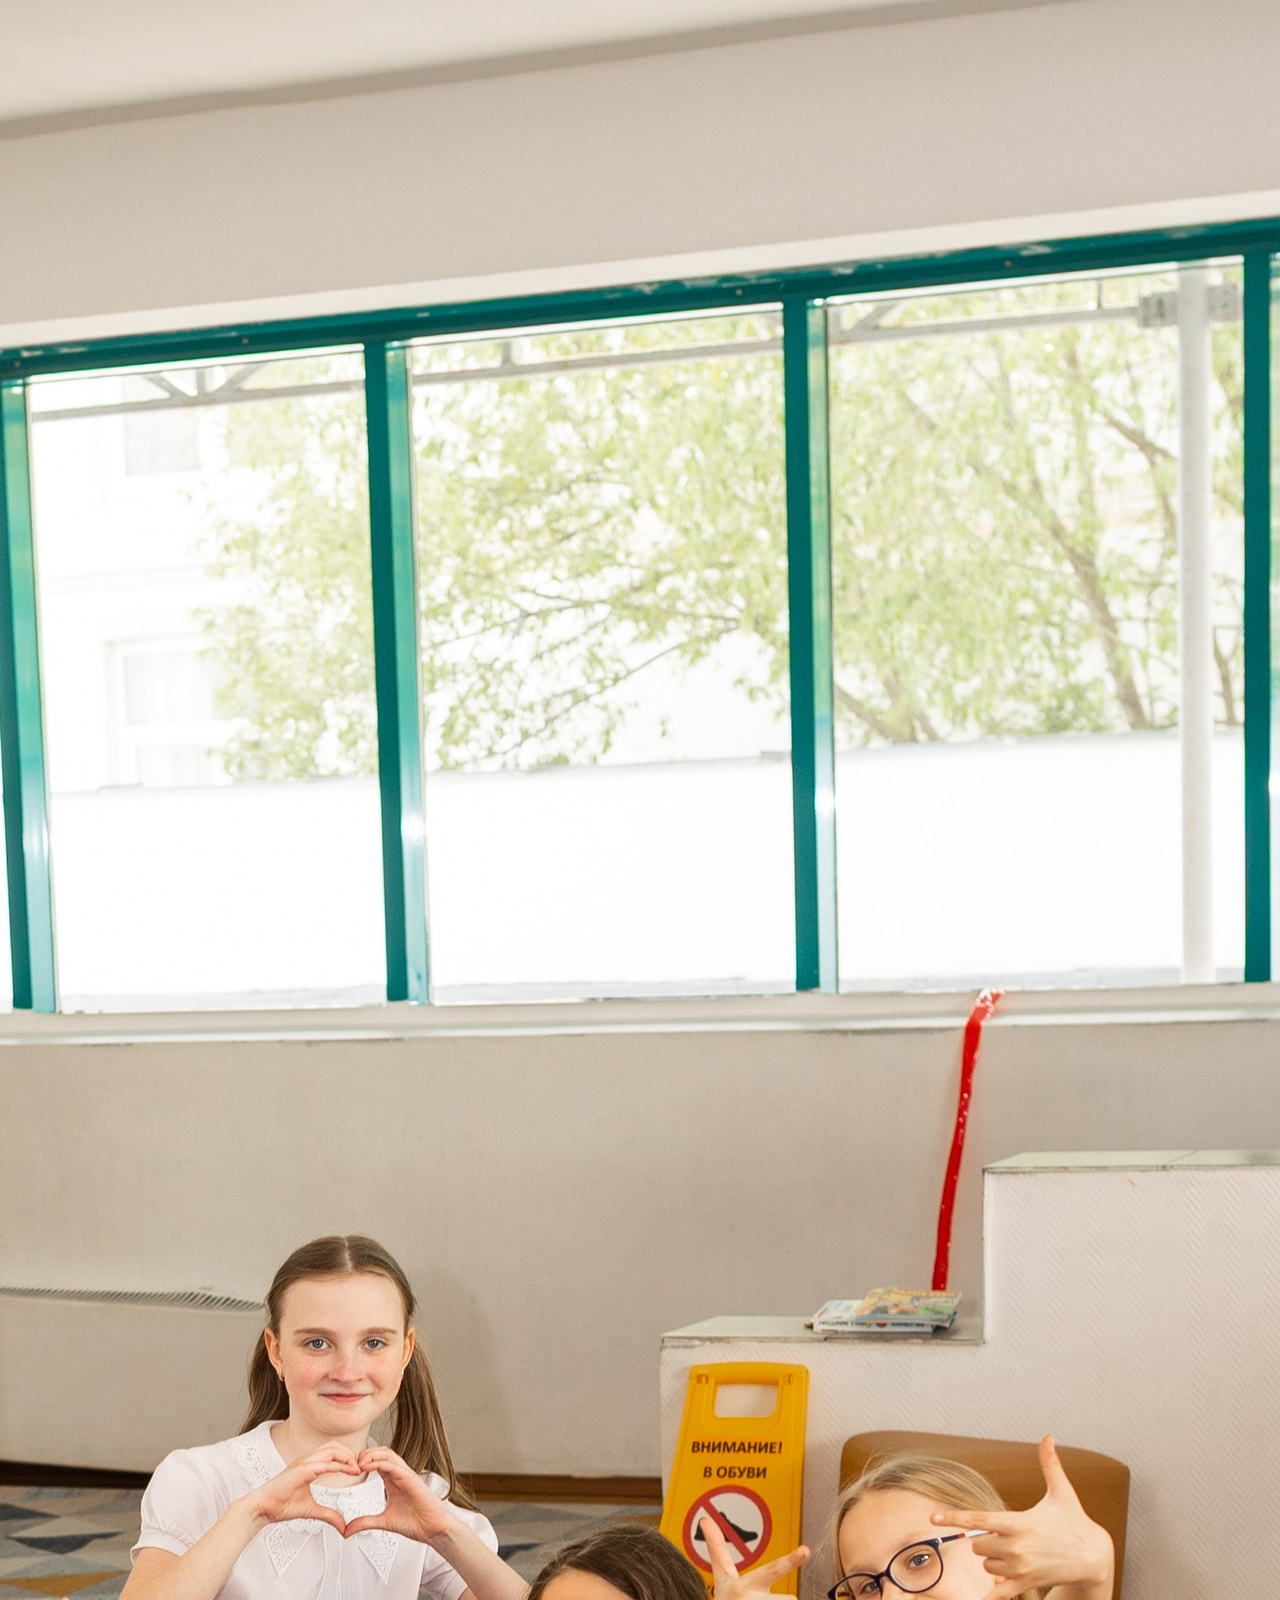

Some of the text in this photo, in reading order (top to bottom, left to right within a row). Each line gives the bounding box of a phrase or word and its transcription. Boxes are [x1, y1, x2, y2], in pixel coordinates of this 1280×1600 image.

[691, 1441, 783, 1454] ВНИМАНИЕ!
[703, 1465, 767, 1479] В ОБУВИ
